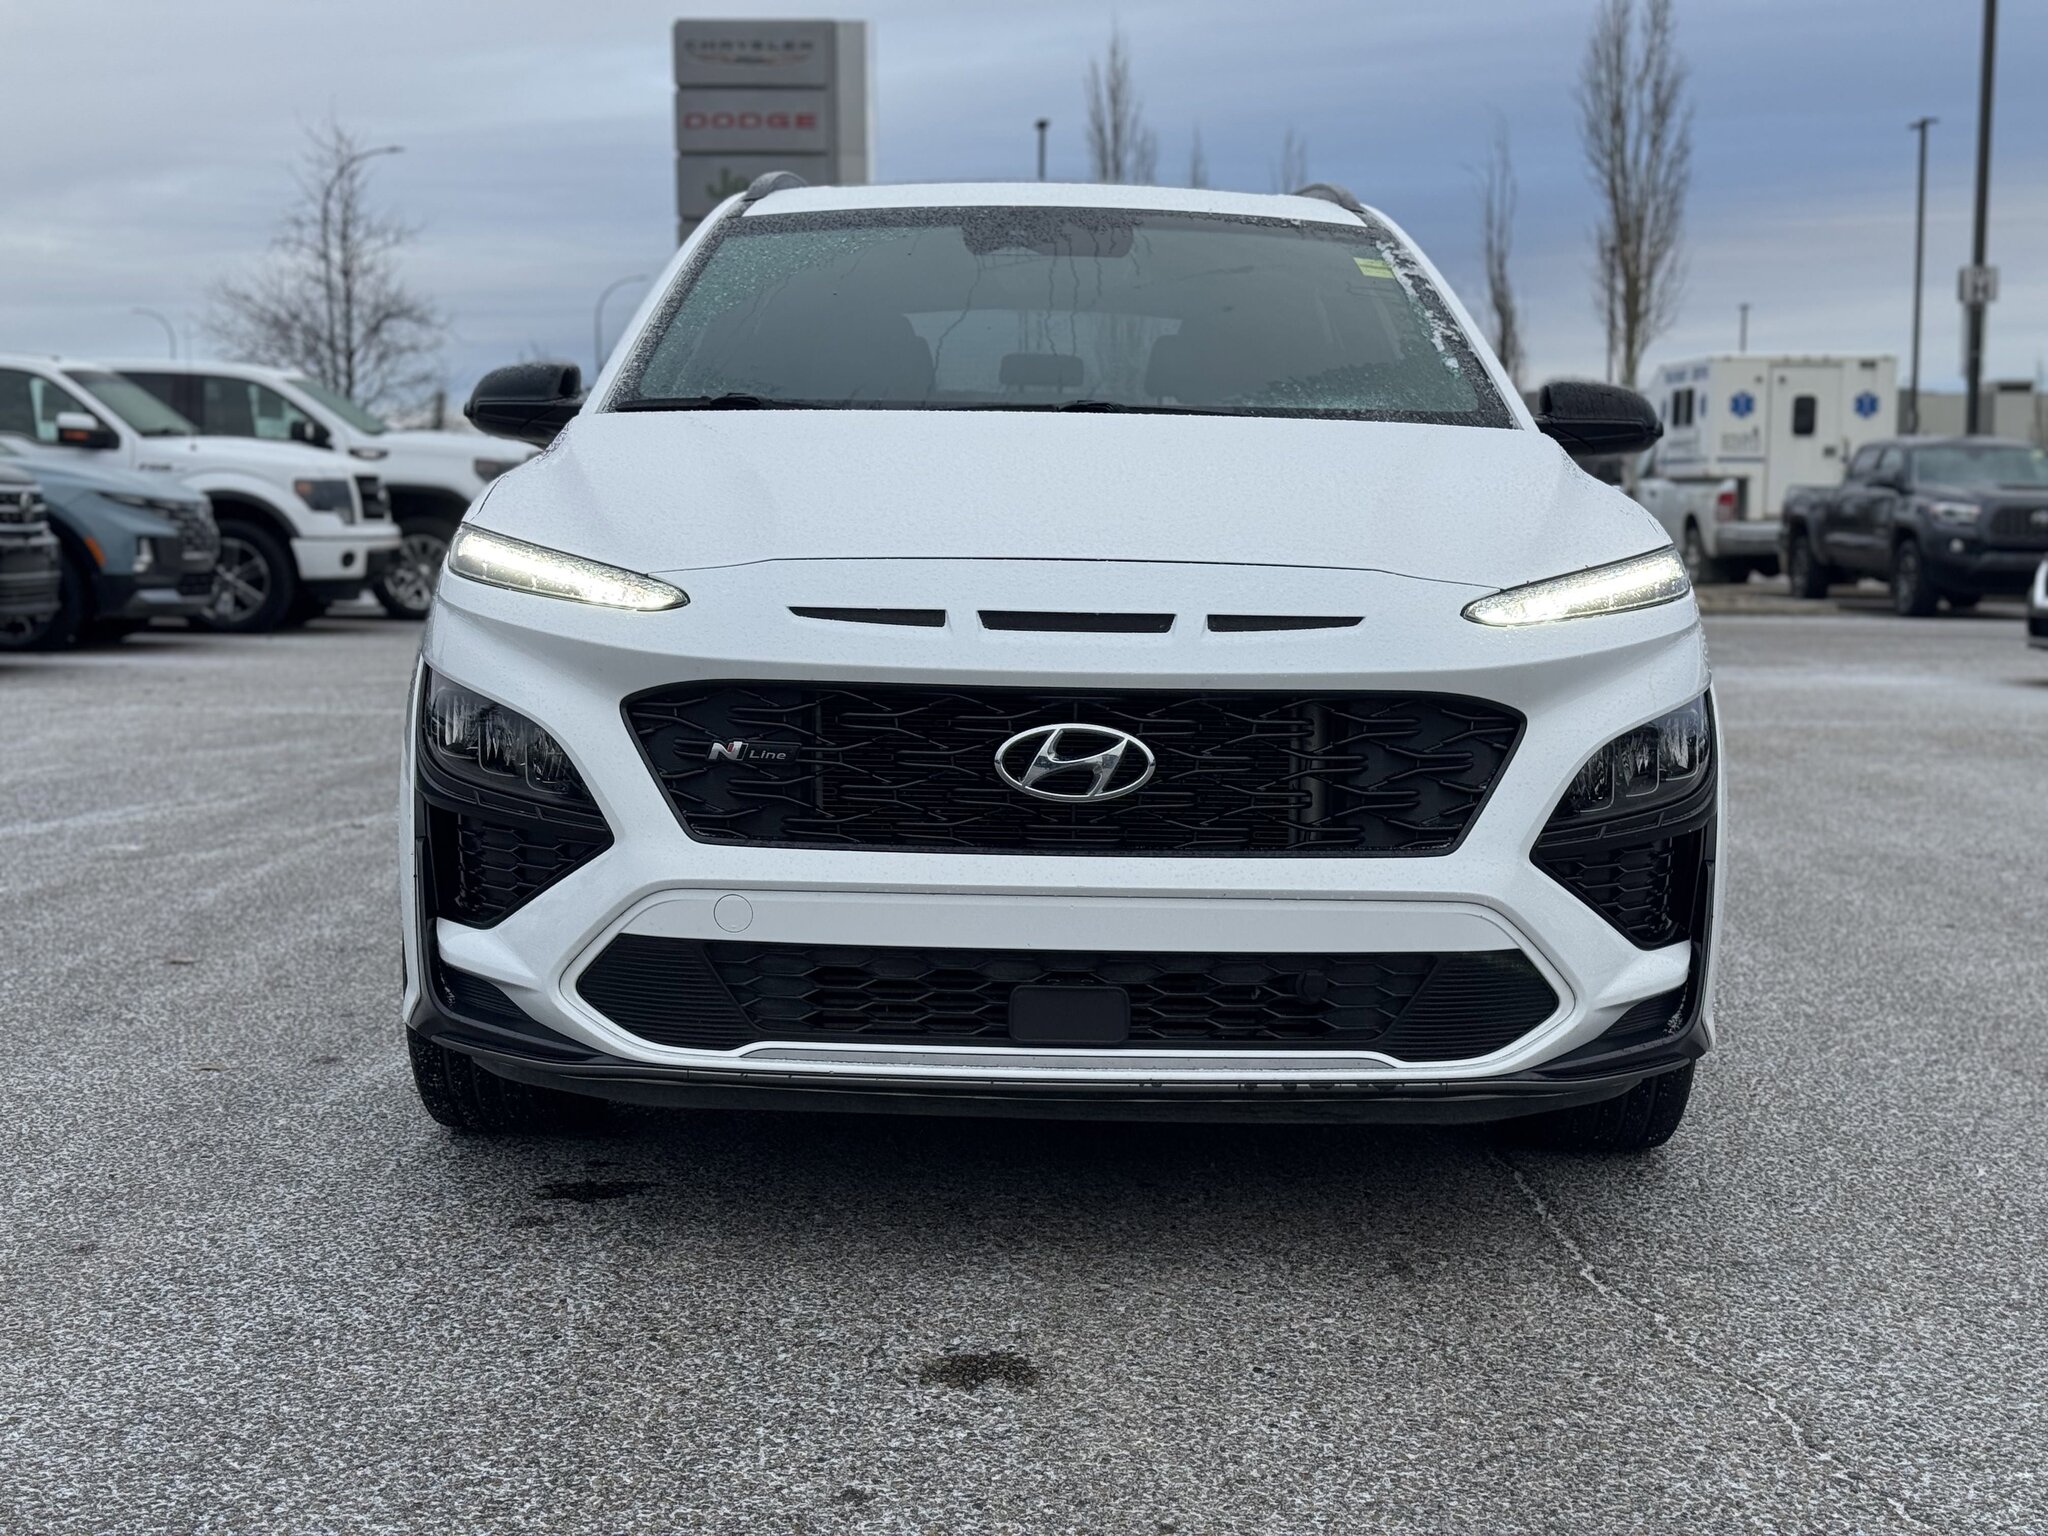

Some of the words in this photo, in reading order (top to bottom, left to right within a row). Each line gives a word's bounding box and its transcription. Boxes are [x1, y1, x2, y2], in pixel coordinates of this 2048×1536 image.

[683, 39, 814, 51] CHRYSLER
[683, 112, 817, 130] DODGE
[708, 741, 746, 761] N
[749, 749, 787, 760] Line
